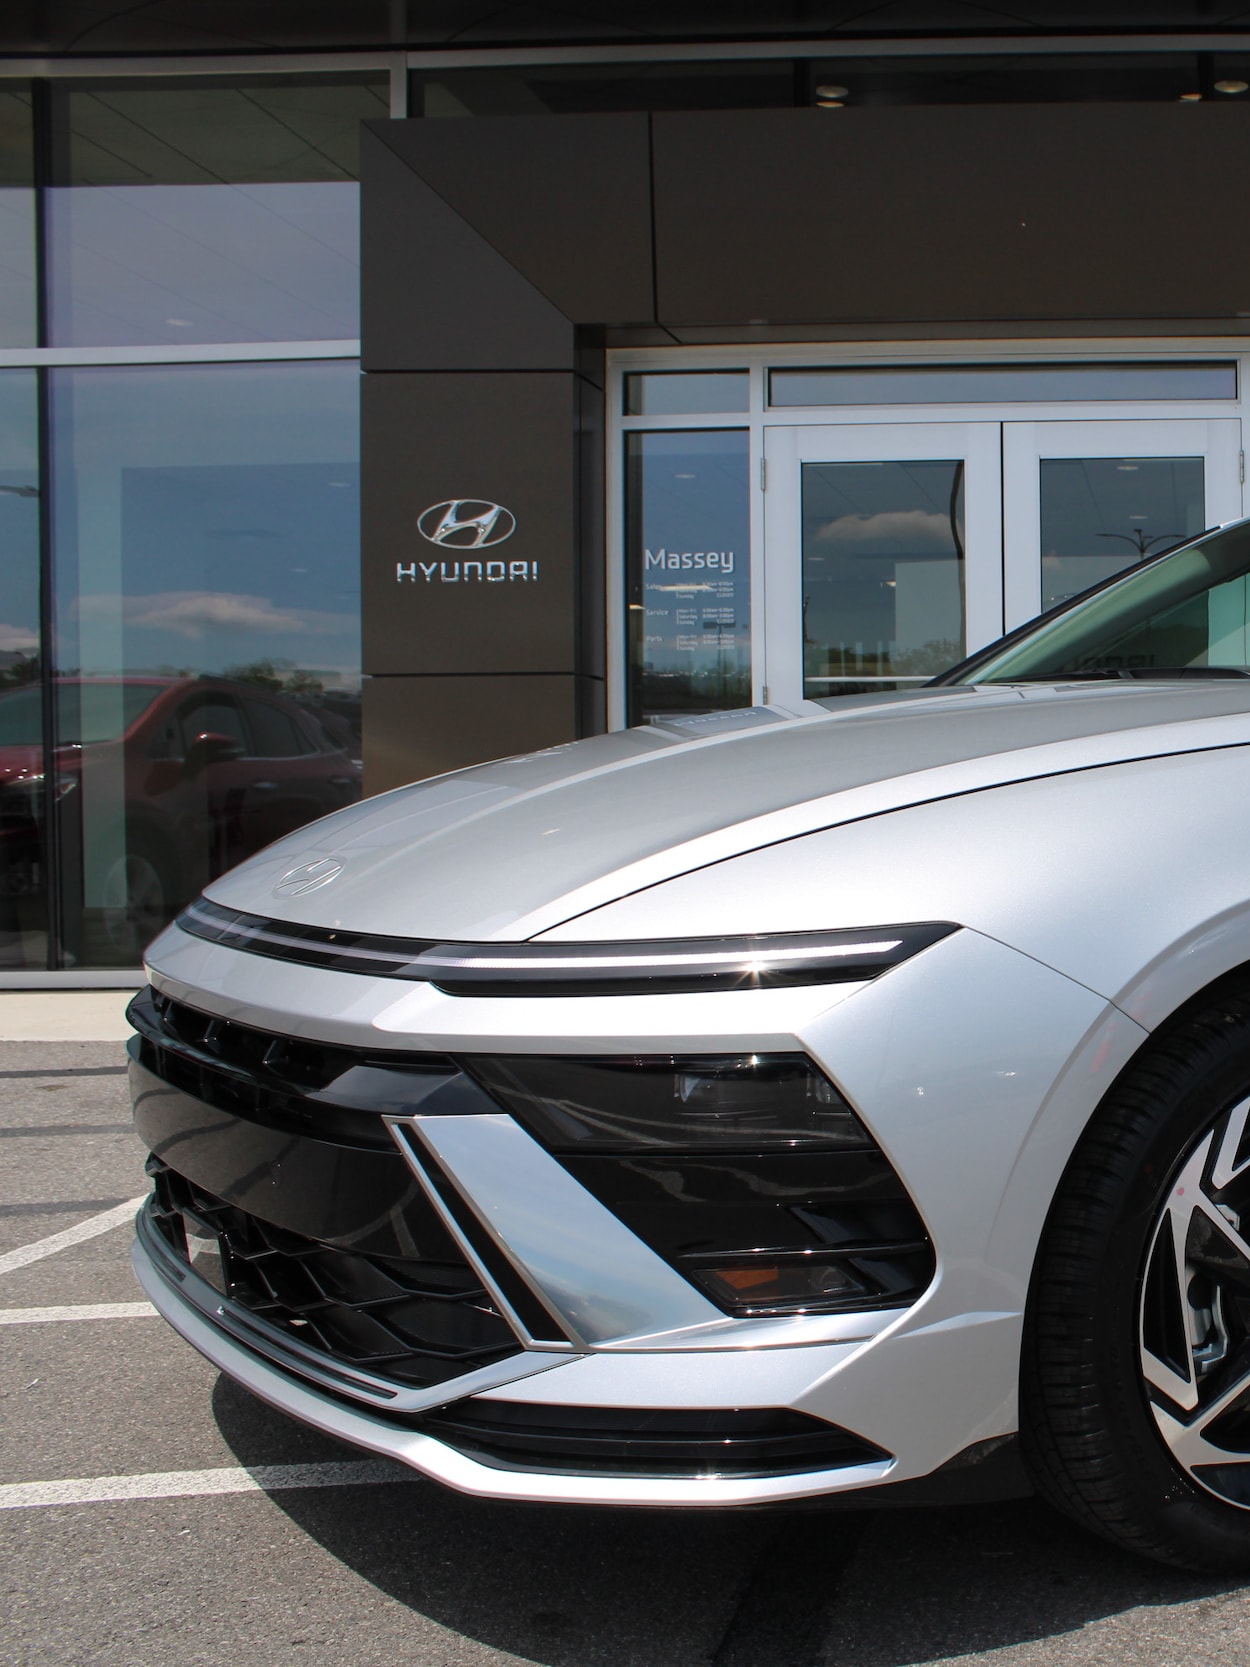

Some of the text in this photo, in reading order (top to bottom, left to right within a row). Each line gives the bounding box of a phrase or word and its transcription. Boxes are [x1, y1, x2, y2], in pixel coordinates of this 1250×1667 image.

[396, 560, 538, 582] HYUNDAI
[644, 548, 734, 573] Massey
[646, 608, 668, 616] Service
